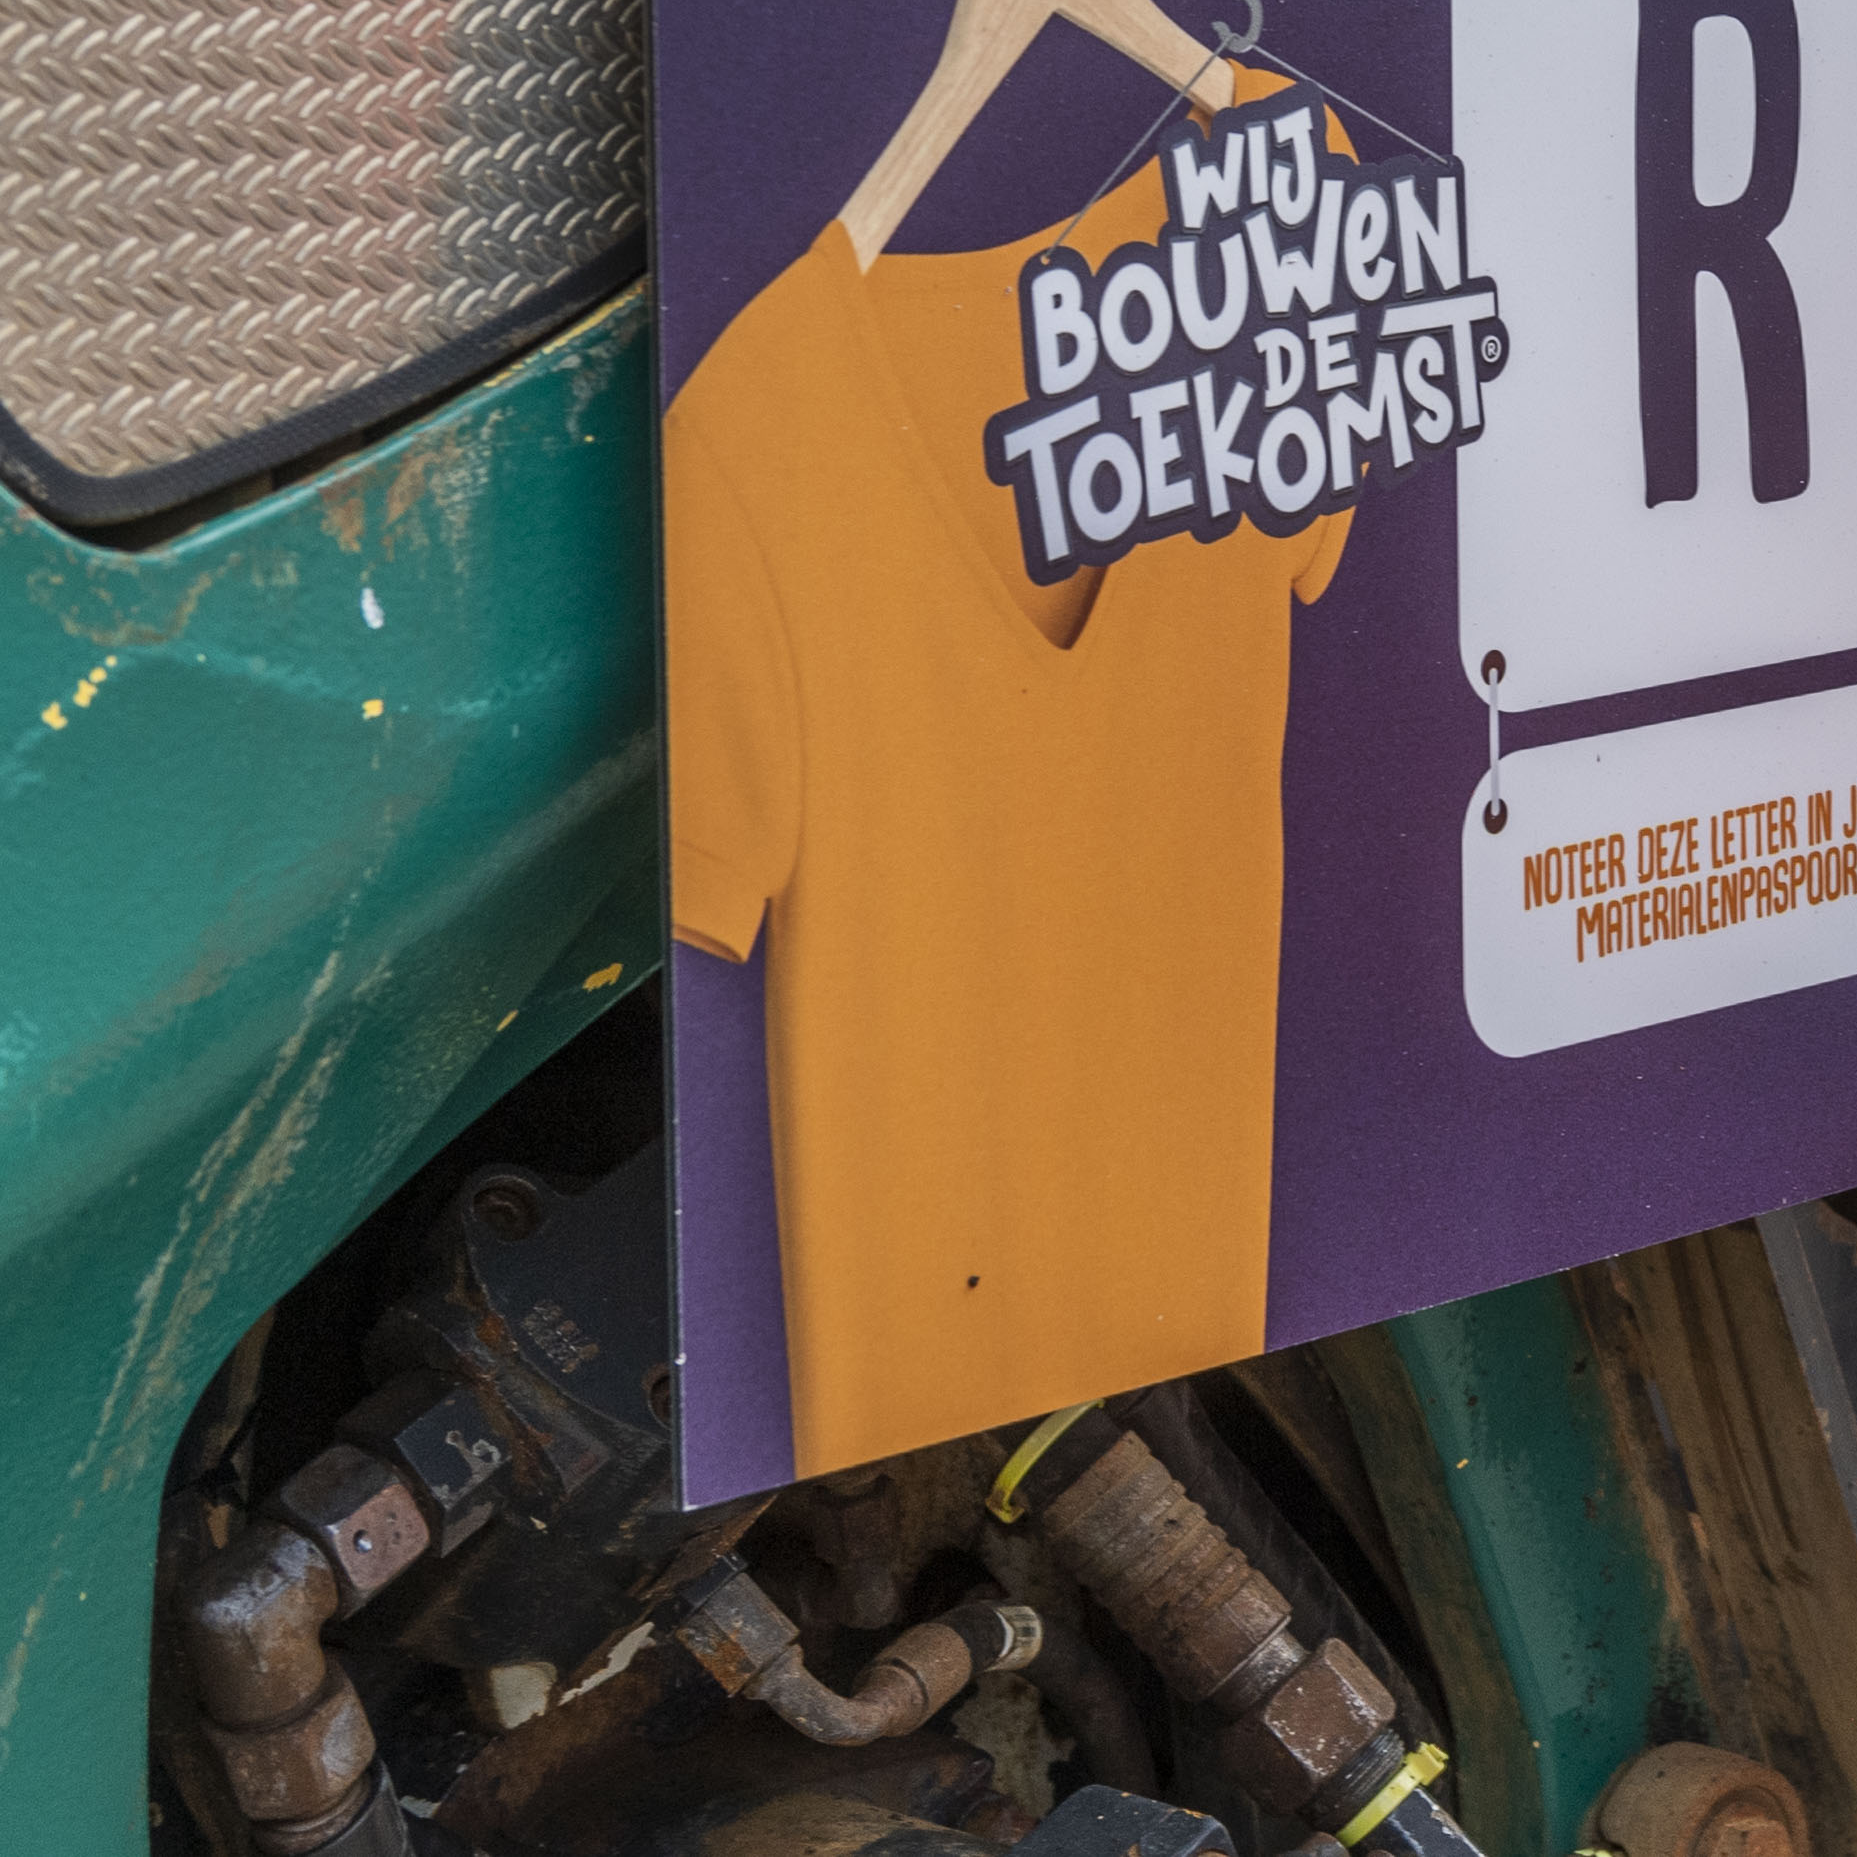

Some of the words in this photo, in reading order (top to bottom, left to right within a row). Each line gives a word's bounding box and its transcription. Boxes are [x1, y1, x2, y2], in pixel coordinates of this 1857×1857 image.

[1171, 106, 1316, 230] WIJ
[1253, 311, 1360, 409] DE
[1523, 833, 1626, 911] NOTEER
[1637, 817, 1700, 885] DEZE
[1710, 796, 1797, 870] LETTER
[1807, 790, 1833, 847] IN
